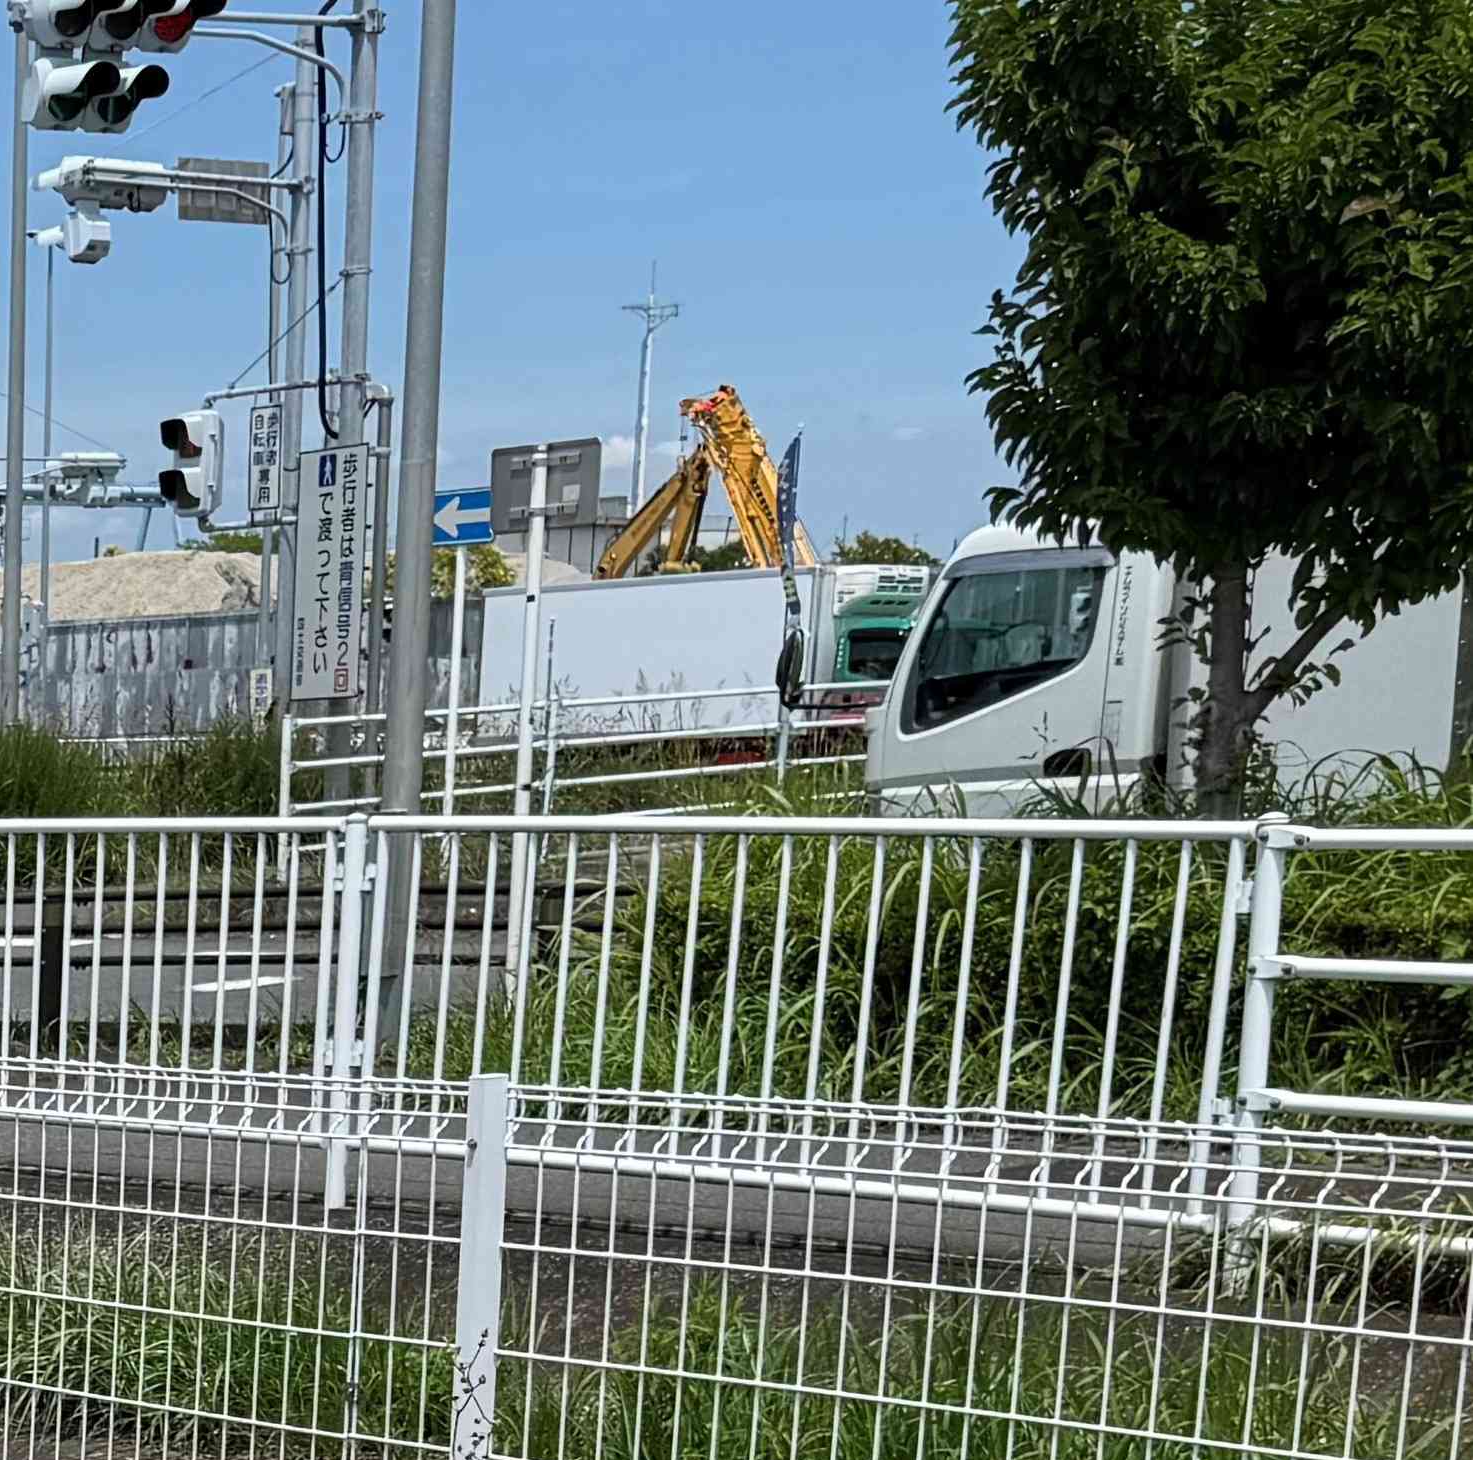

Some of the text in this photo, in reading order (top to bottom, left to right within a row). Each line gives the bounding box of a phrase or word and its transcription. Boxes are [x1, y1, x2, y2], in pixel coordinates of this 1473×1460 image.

[312, 491, 334, 676] で渡って下さい
[333, 453, 359, 693] 歩行者は青信号2回
